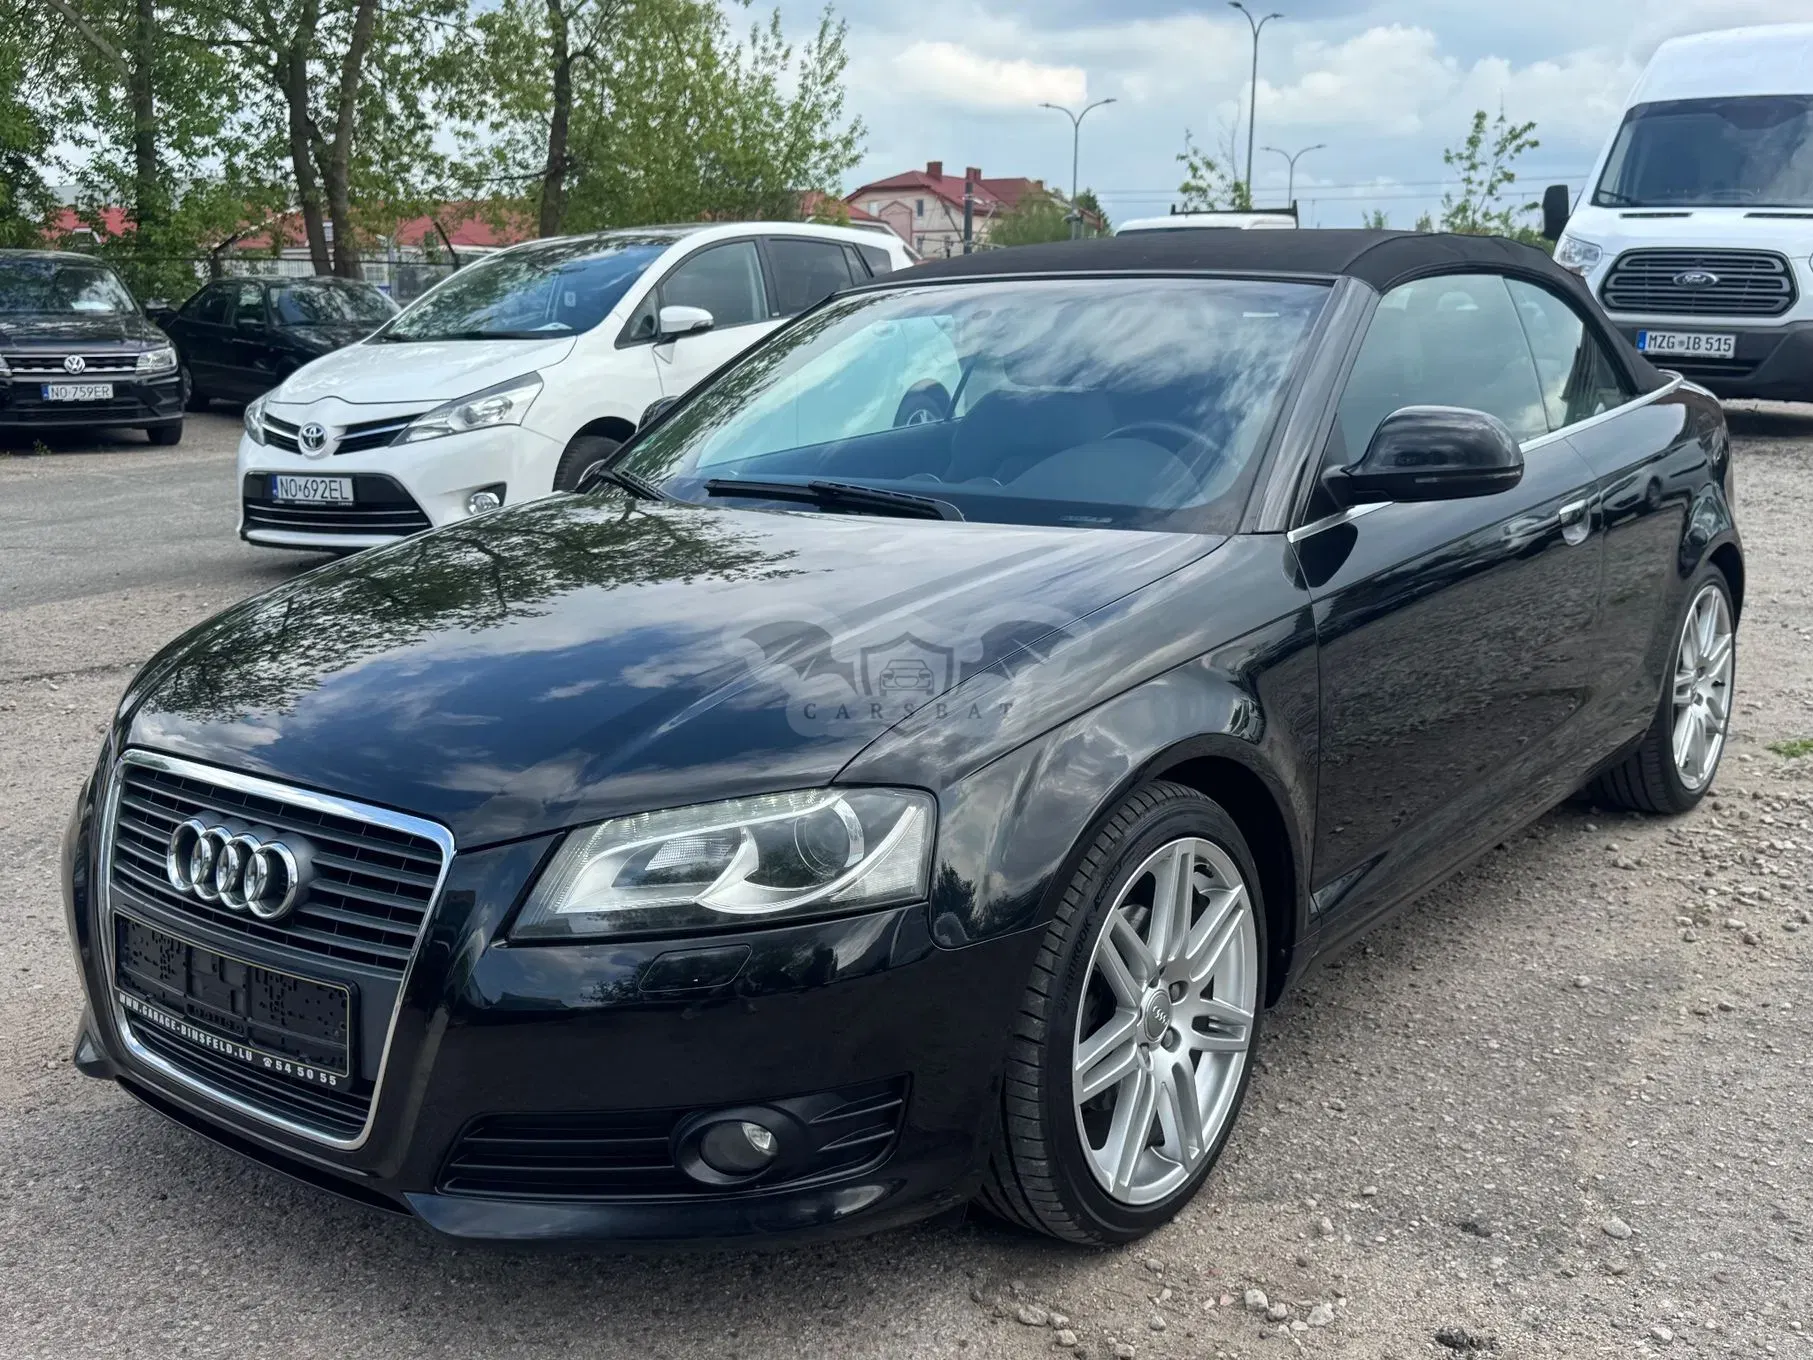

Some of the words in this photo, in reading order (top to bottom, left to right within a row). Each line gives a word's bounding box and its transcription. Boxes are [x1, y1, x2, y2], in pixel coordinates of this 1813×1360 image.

[1648, 335, 1676, 349] MZG
[1684, 336, 1702, 350] IB
[1704, 337, 1731, 352] 515
[51, 386, 68, 398] NO
[72, 386, 110, 398] 759ER
[279, 478, 297, 497] NO
[303, 479, 349, 500] 692EL
[118, 992, 253, 1062] WWW.GARAGE-BINSFELD.LU
[275, 1061, 292, 1074] 54
[297, 1067, 314, 1080] 50
[320, 1073, 337, 1086] 55
